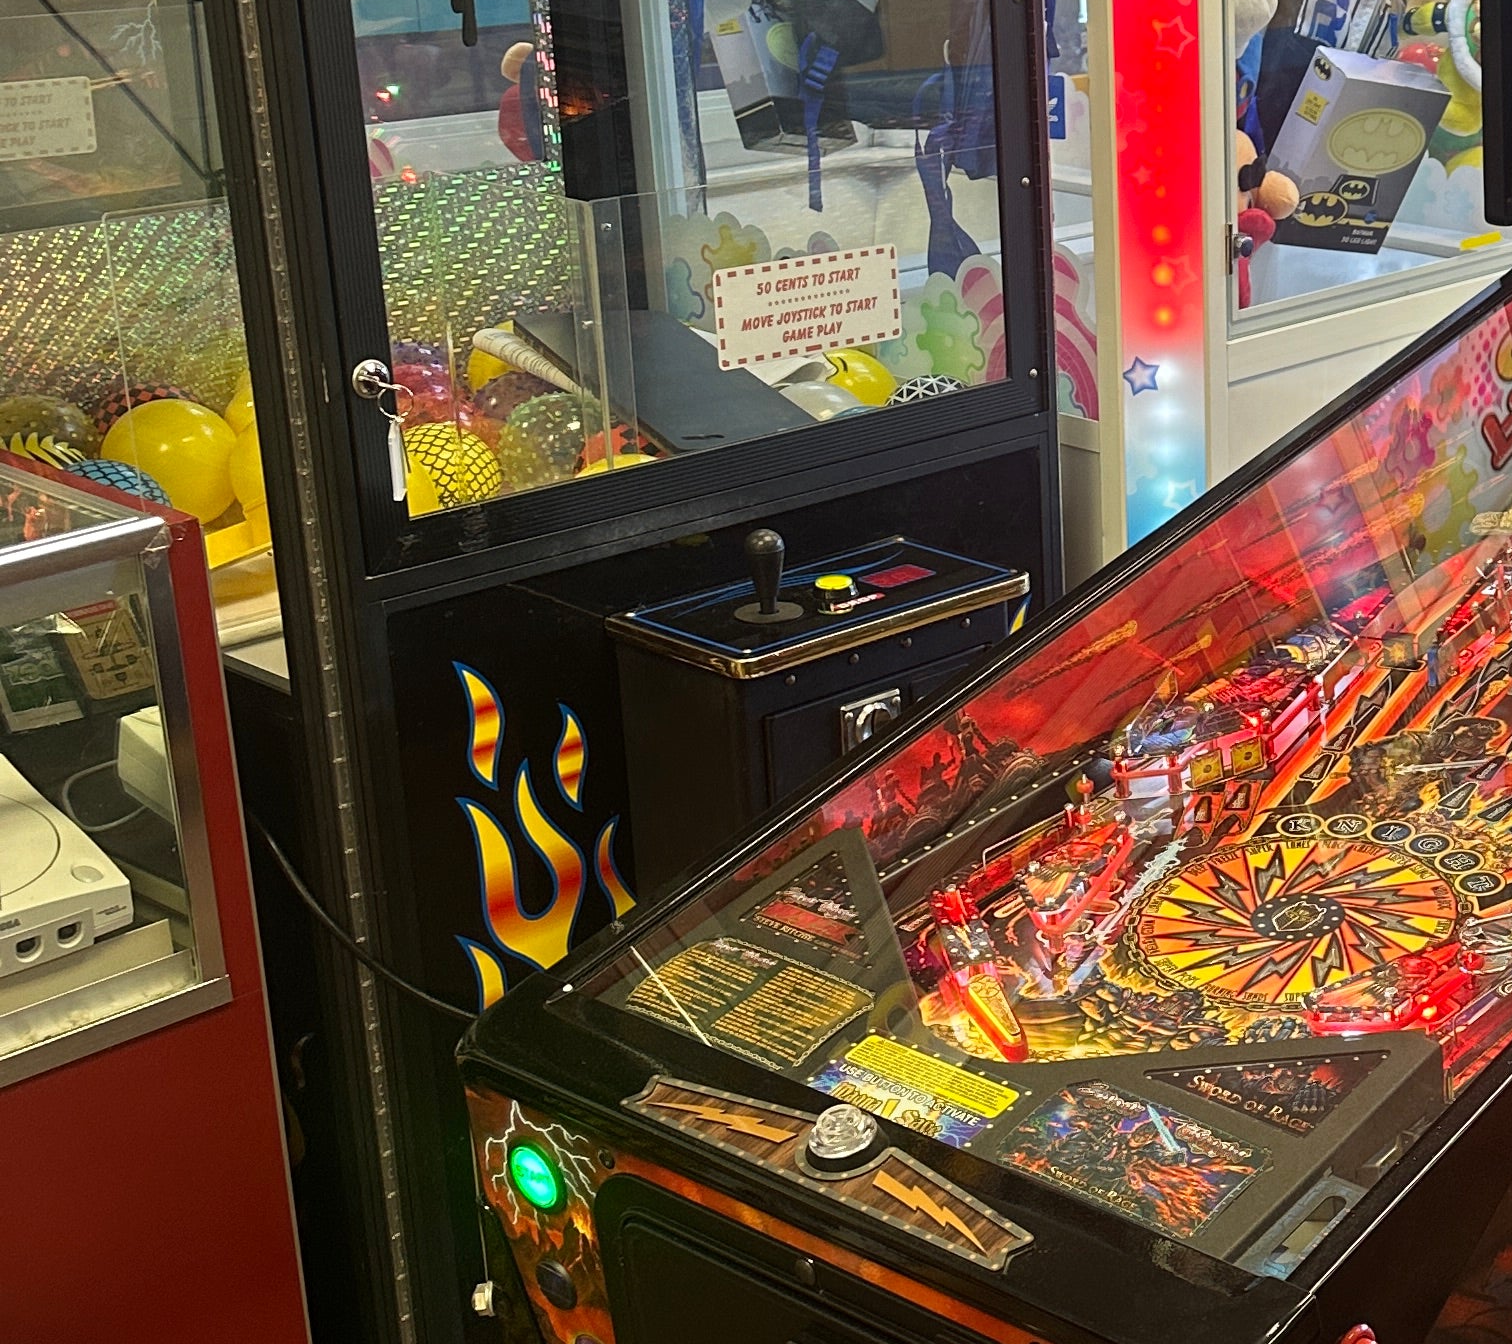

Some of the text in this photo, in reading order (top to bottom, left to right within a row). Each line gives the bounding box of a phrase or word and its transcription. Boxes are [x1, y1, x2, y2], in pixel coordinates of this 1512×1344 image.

[756, 267, 861, 296] 50 CENTS TO START
[741, 296, 878, 332] MOVE JOYSTICK TO START
[782, 321, 843, 343] GAME PLAY
[838, 1062, 981, 1127] USE BUTTON TO ACTIVATE
[1245, 1098, 1267, 1117] OF
